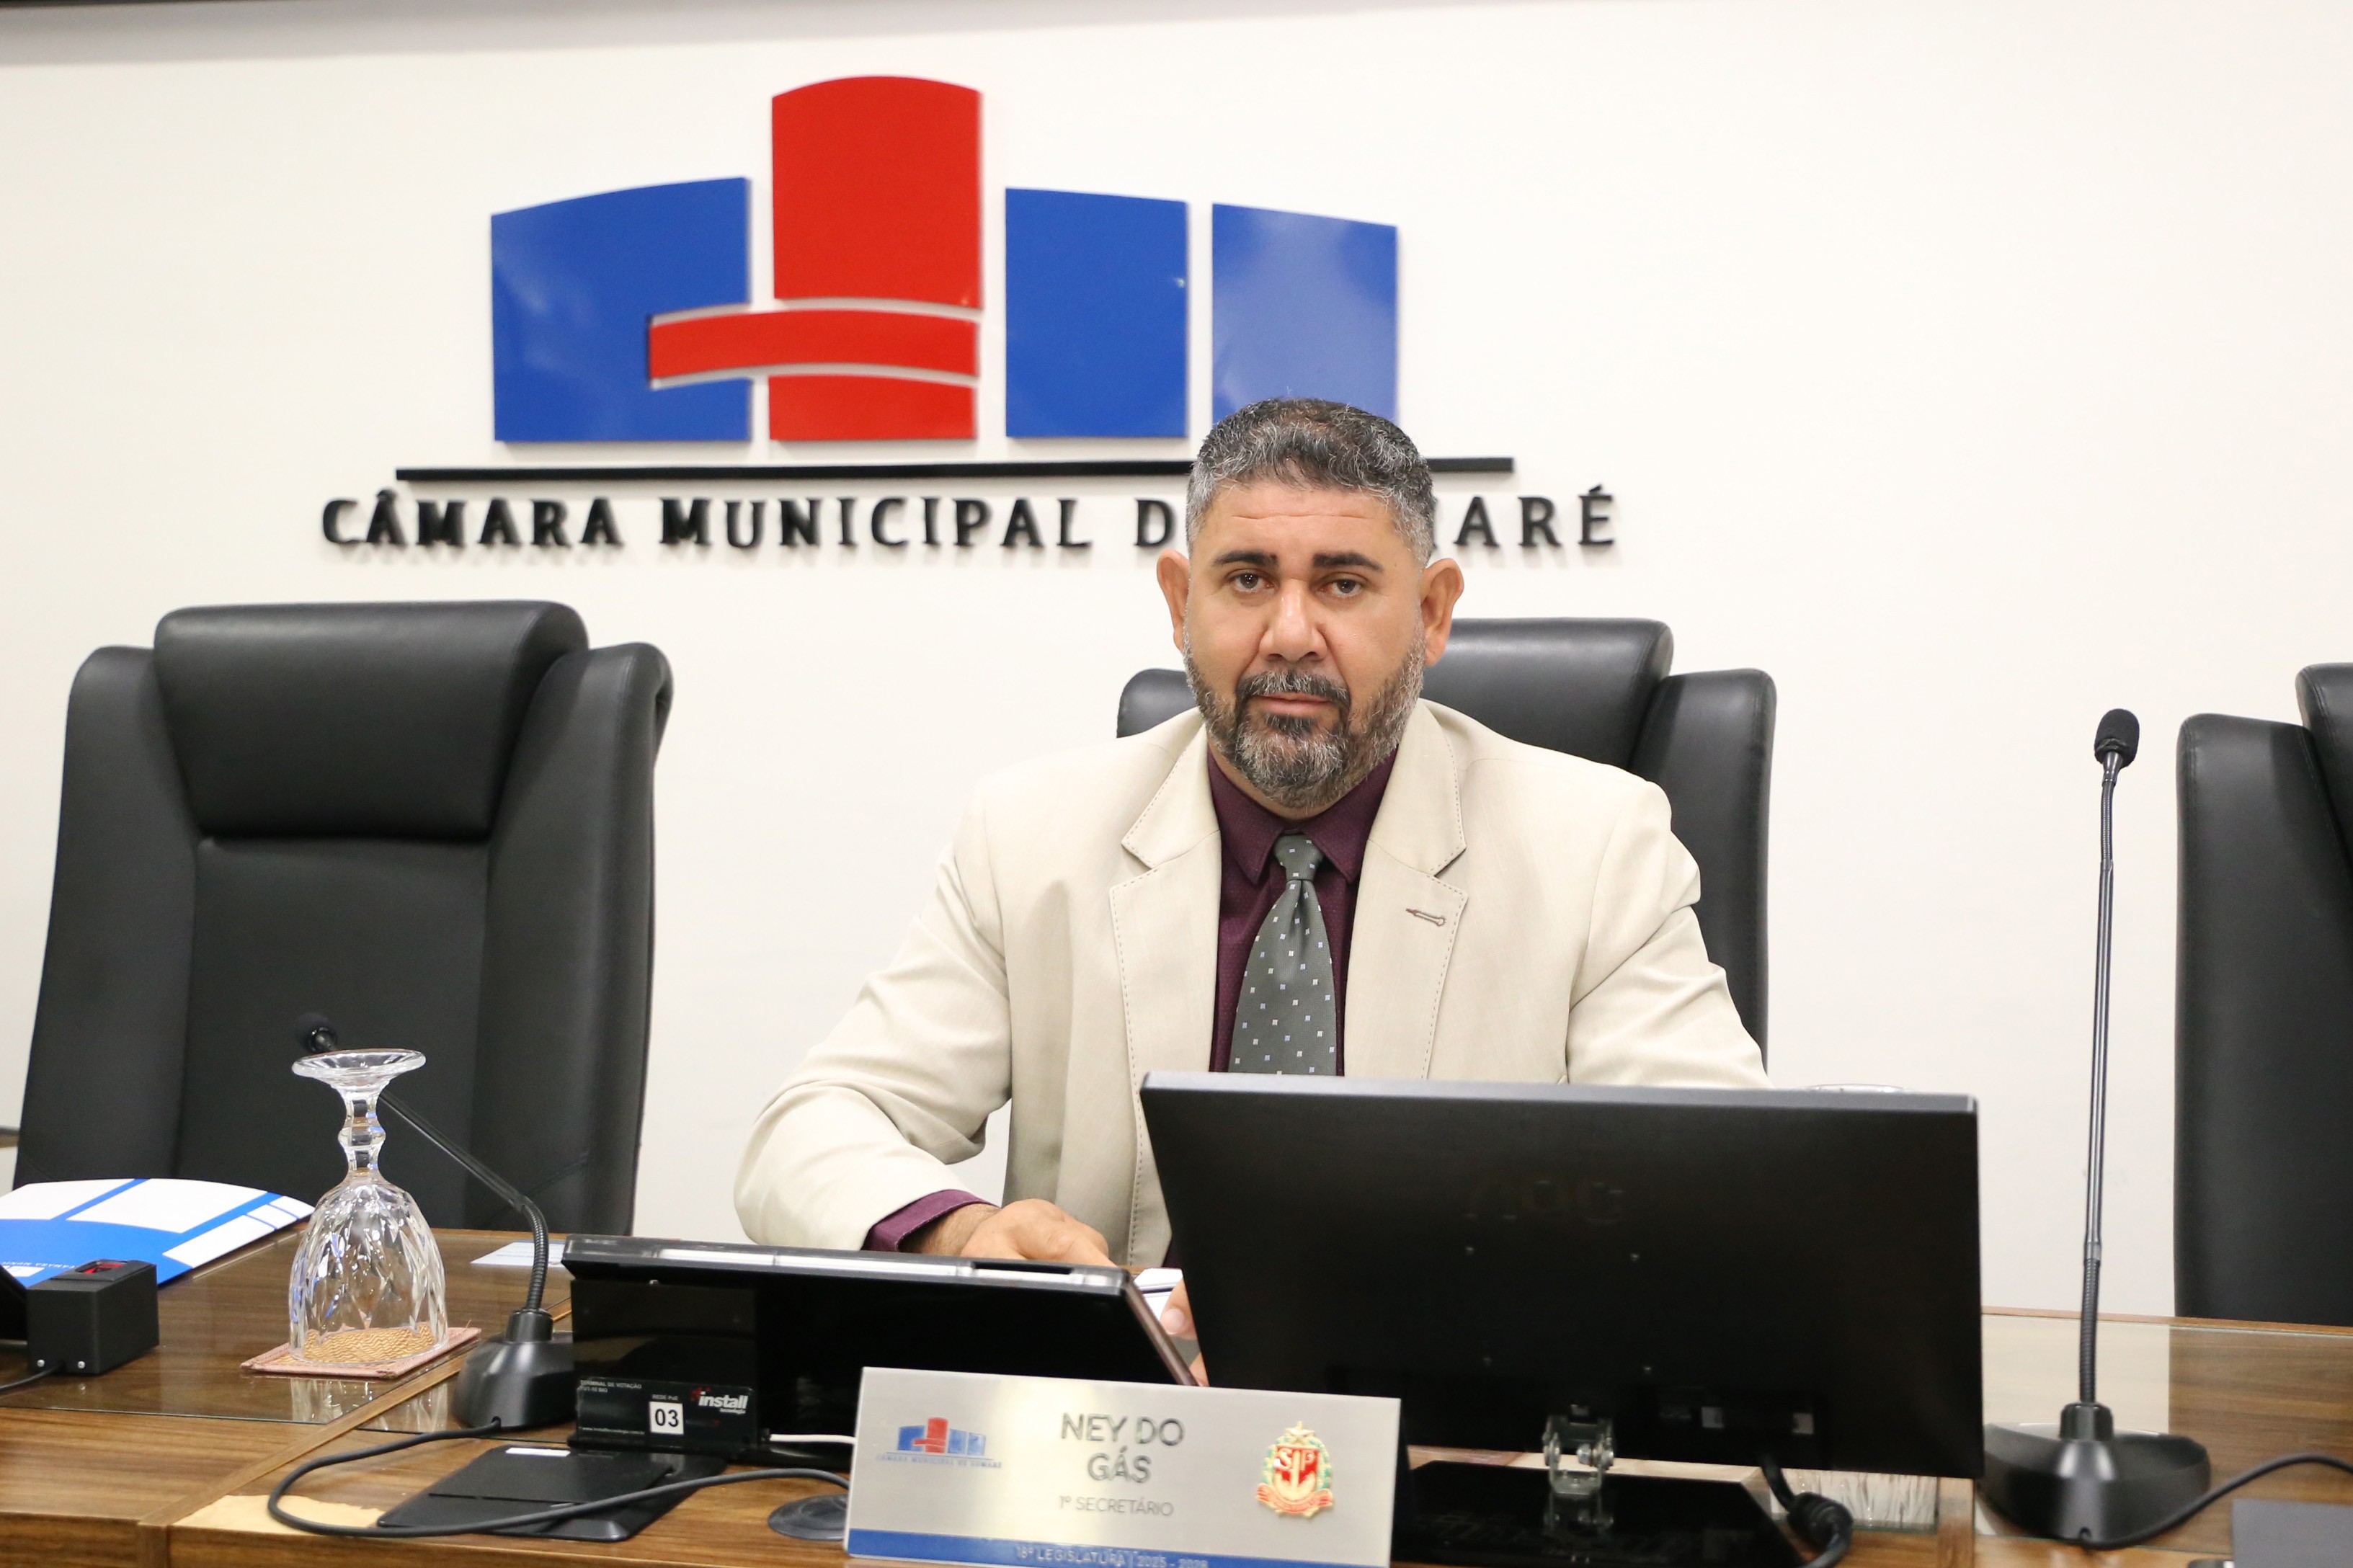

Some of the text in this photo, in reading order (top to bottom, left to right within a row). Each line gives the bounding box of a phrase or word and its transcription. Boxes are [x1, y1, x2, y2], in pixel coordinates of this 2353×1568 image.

[322, 486, 1614, 550] CÂMARA MUNICIPAL D ARÉ
[698, 1391, 749, 1409] install
[655, 1408, 679, 1427] 03
[1061, 1412, 1186, 1446] NEY DO
[1087, 1446, 1152, 1484] GÁS
[1076, 1497, 1175, 1516] SECRETÁRIO
[1037, 1548, 1126, 1567] LEGISLATURA
[1137, 1555, 1167, 1568] 2025
